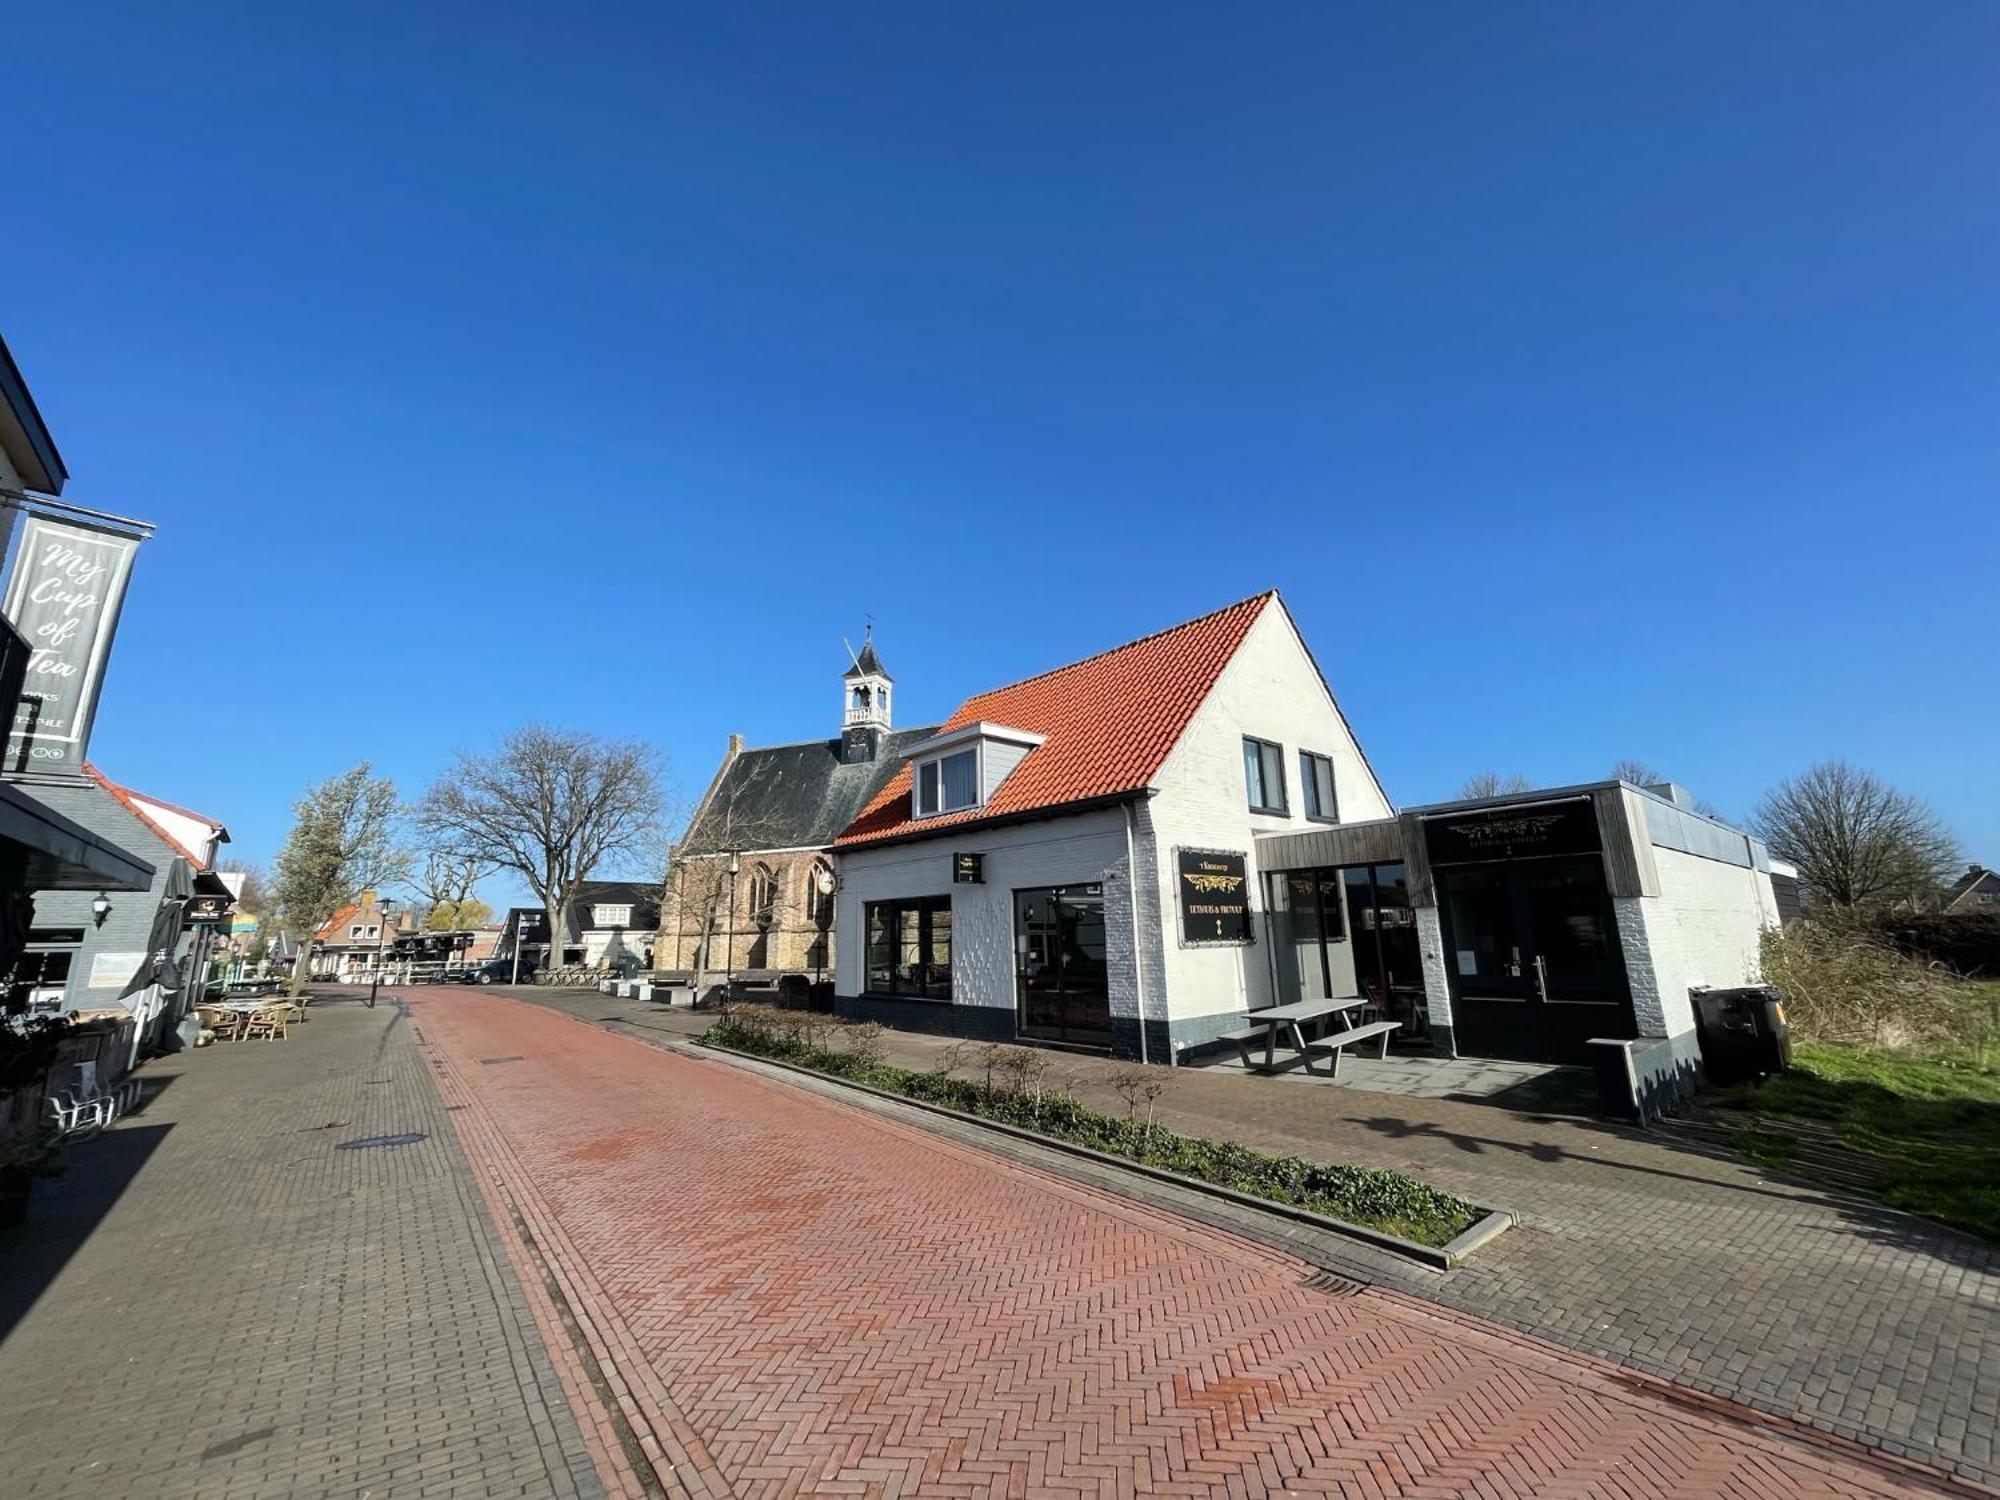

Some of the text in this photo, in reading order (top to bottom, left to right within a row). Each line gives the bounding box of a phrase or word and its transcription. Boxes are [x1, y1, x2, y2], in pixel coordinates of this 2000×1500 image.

[41, 542, 106, 585] My
[30, 577, 99, 615] Cup
[37, 617, 80, 646] of
[26, 648, 77, 678] Tea
